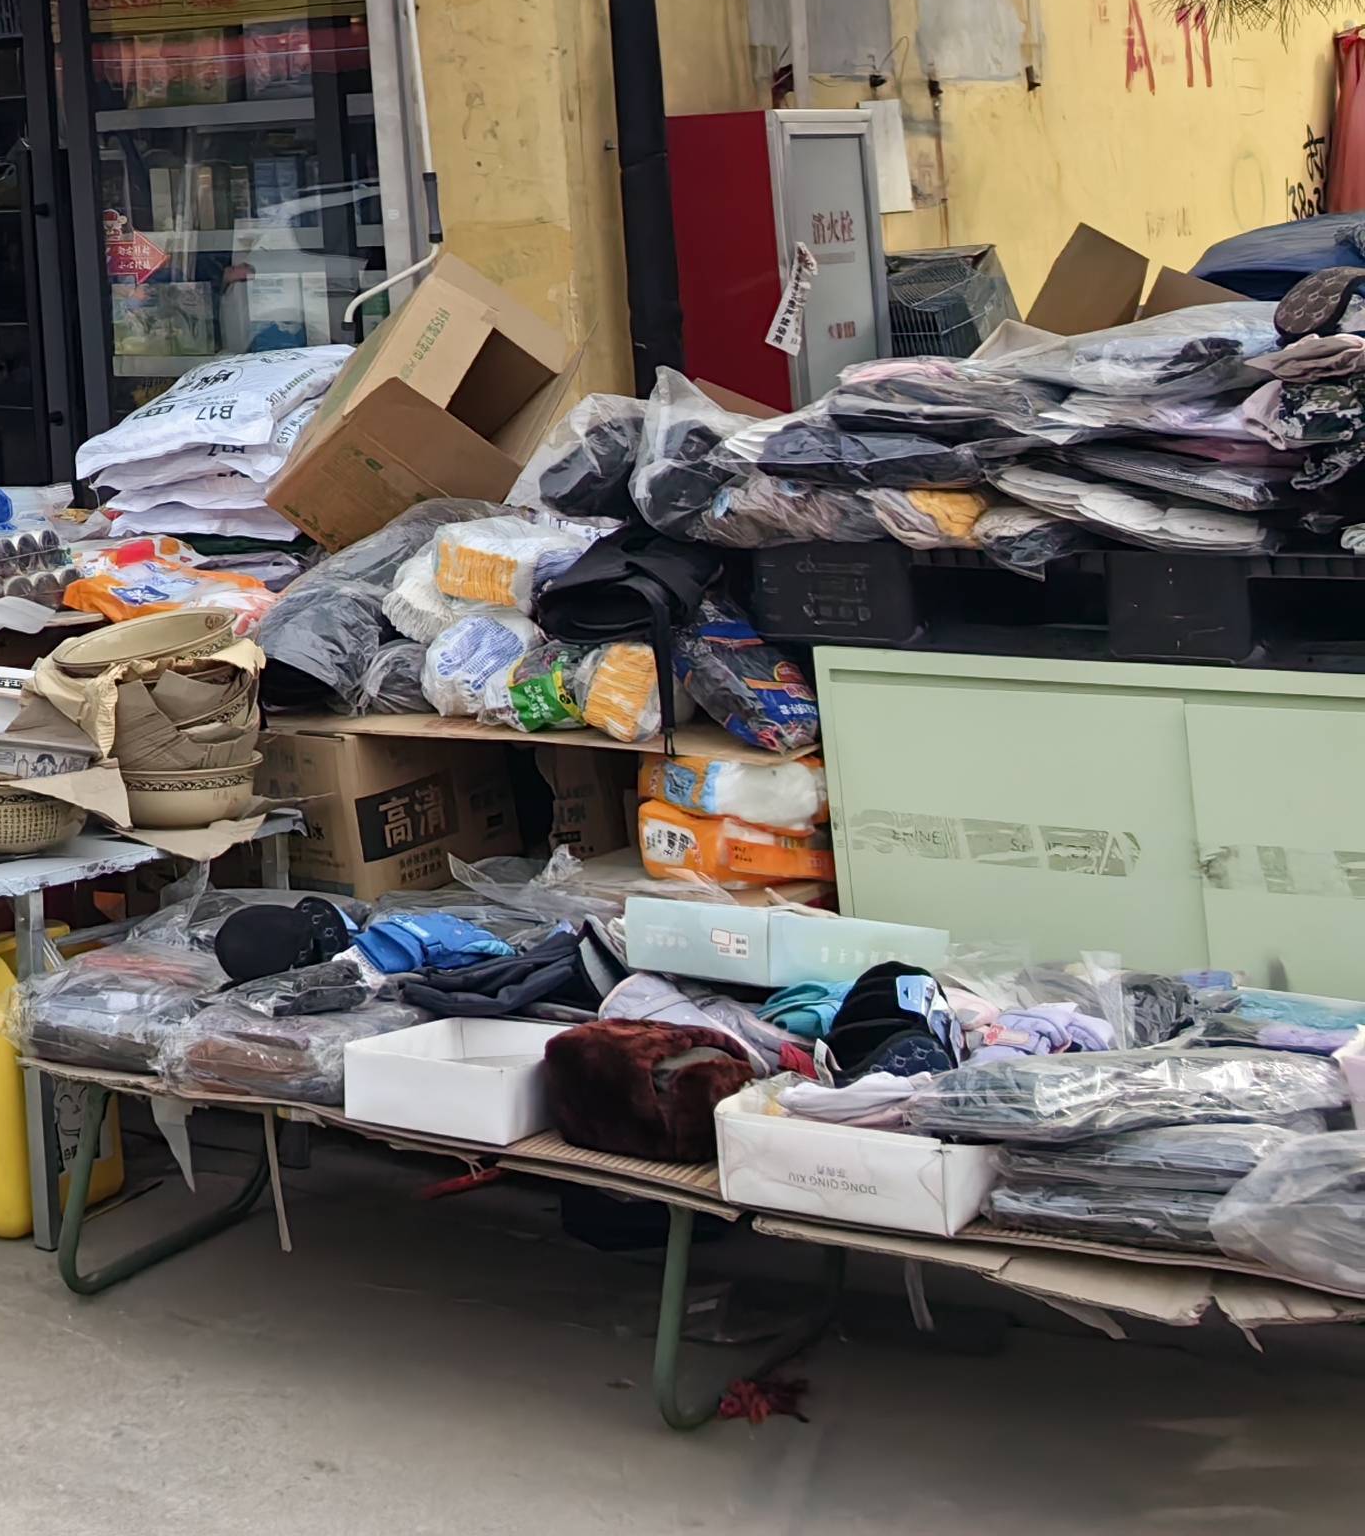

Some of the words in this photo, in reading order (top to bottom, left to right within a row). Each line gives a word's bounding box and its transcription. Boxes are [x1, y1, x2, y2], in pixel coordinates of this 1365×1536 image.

[812, 210, 856, 245] 消火栓
[195, 405, 233, 421] B17
[379, 785, 447, 849] 高清
